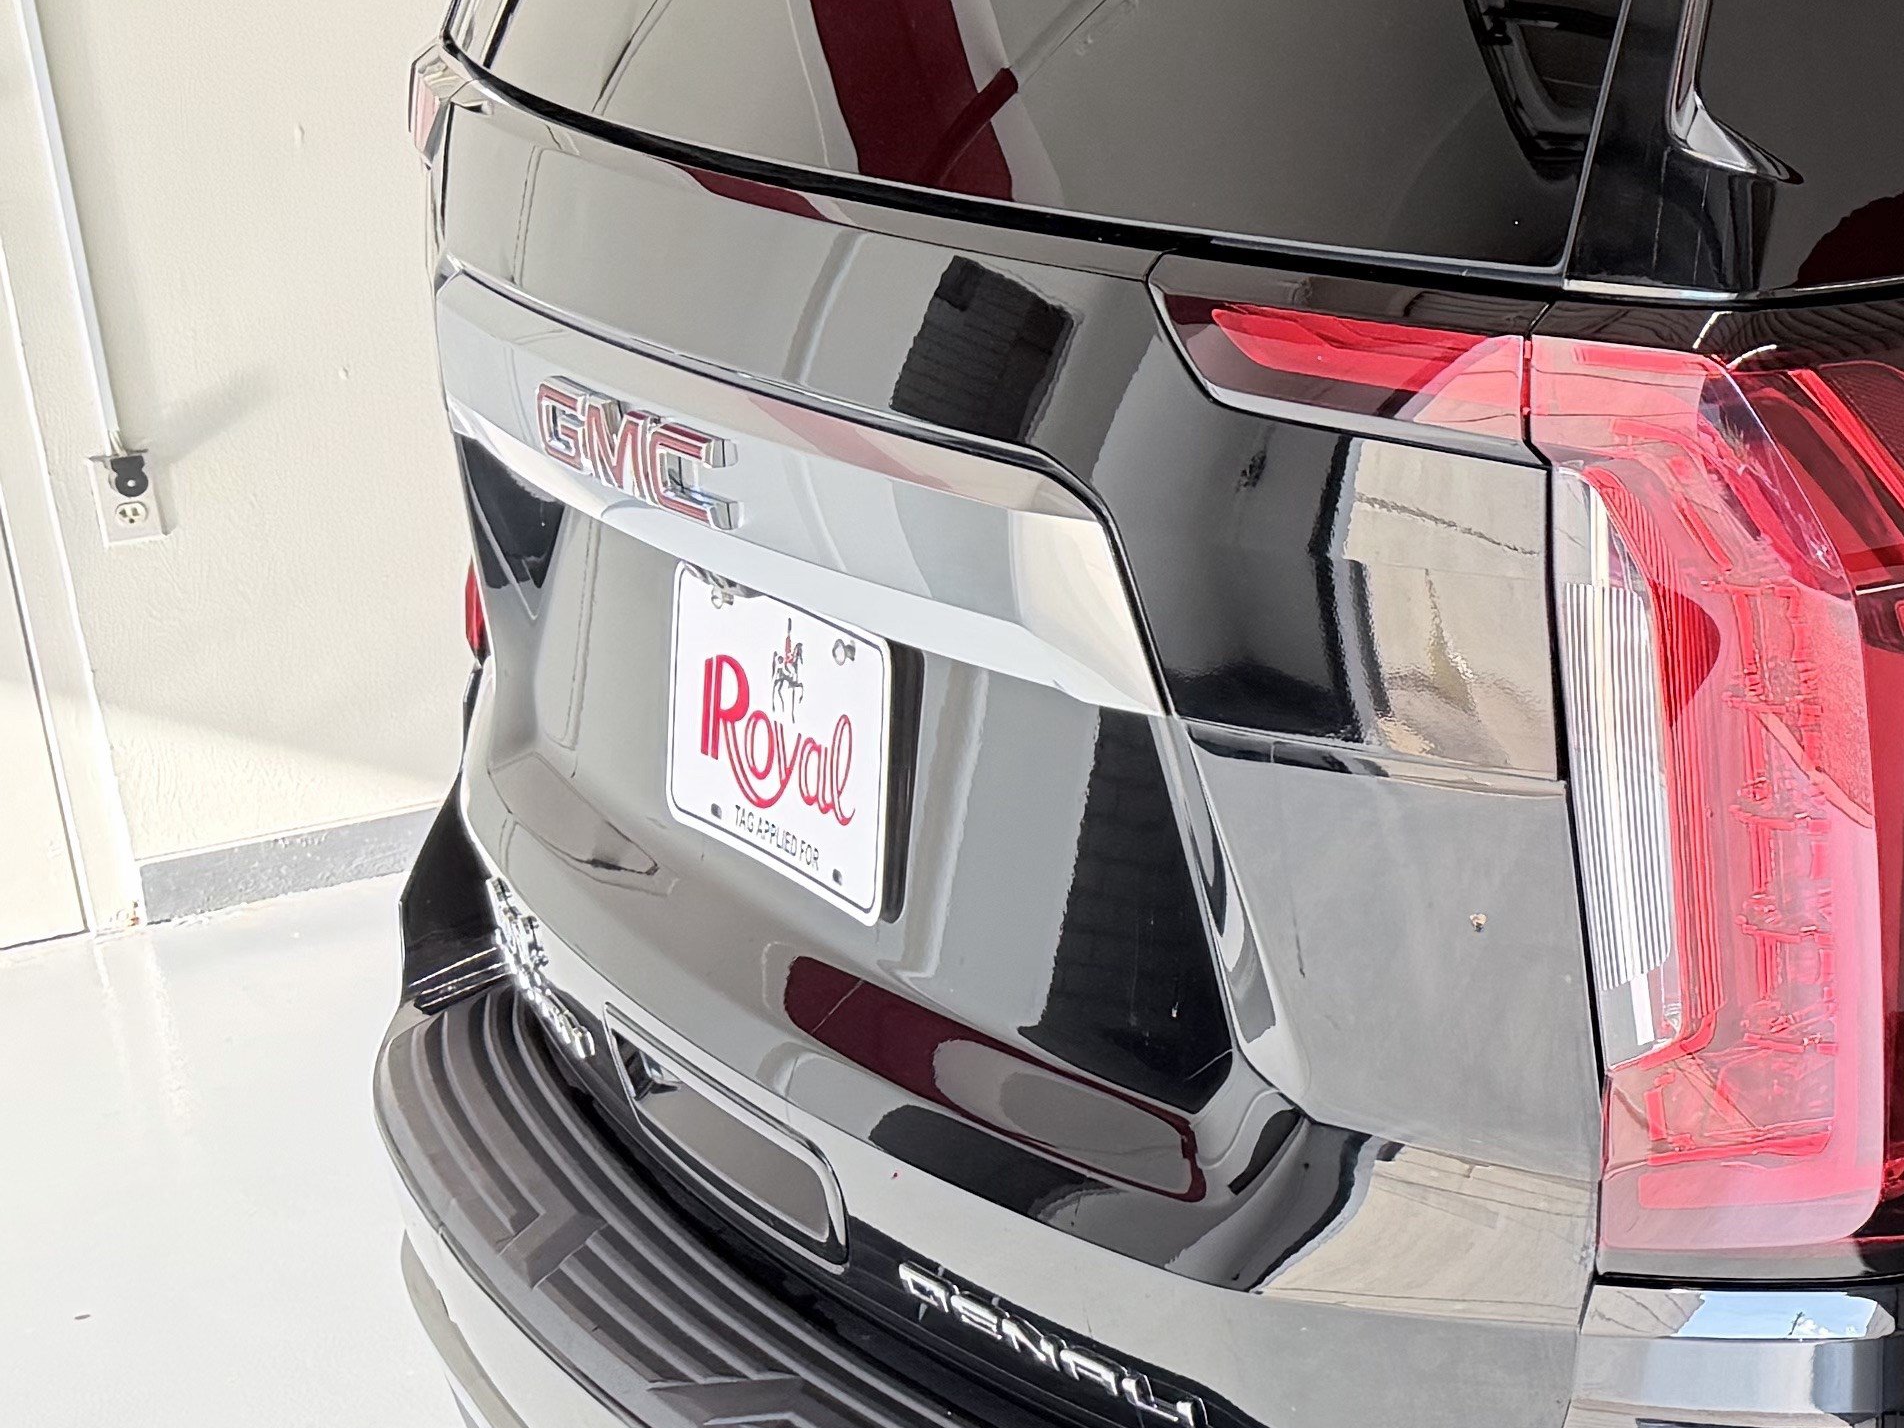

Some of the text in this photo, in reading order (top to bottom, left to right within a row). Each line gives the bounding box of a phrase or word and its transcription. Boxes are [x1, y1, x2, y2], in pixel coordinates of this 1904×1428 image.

[536, 375, 744, 530] GMC
[701, 654, 856, 826] Royal
[735, 804, 820, 870] TAG APPLIED FOR
